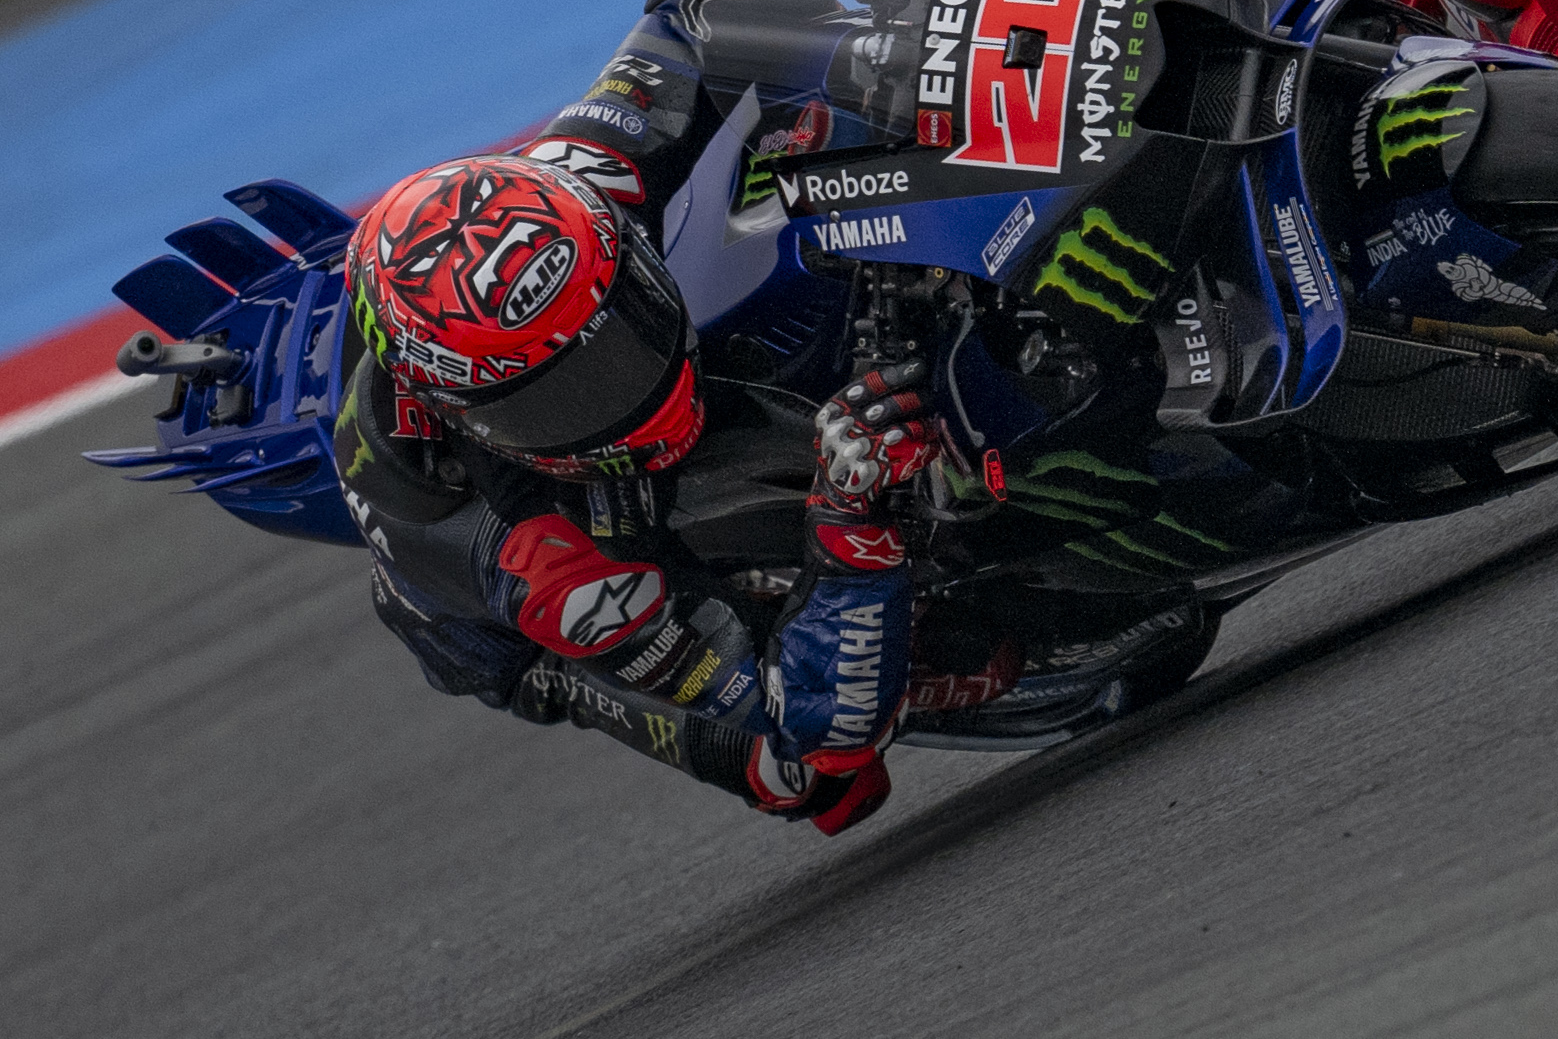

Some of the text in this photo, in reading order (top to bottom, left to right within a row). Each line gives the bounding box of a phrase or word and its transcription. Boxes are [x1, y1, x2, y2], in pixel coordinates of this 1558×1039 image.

[558, 104, 622, 128] YAMAH
[805, 169, 910, 202] Roboze
[812, 215, 907, 251] YAMAHA
[988, 206, 1026, 257] BLUE
[993, 219, 1030, 268] CORE
[1412, 208, 1456, 246] BLUE
[1274, 203, 1318, 308] YAMALUBE
[1366, 237, 1408, 267] INDIA
[508, 243, 572, 322] HJC
[1175, 297, 1212, 386] REEVO
[616, 618, 685, 684] YAMALUBE
[820, 601, 885, 749] YAMAHA
[720, 672, 754, 708] INDIA
